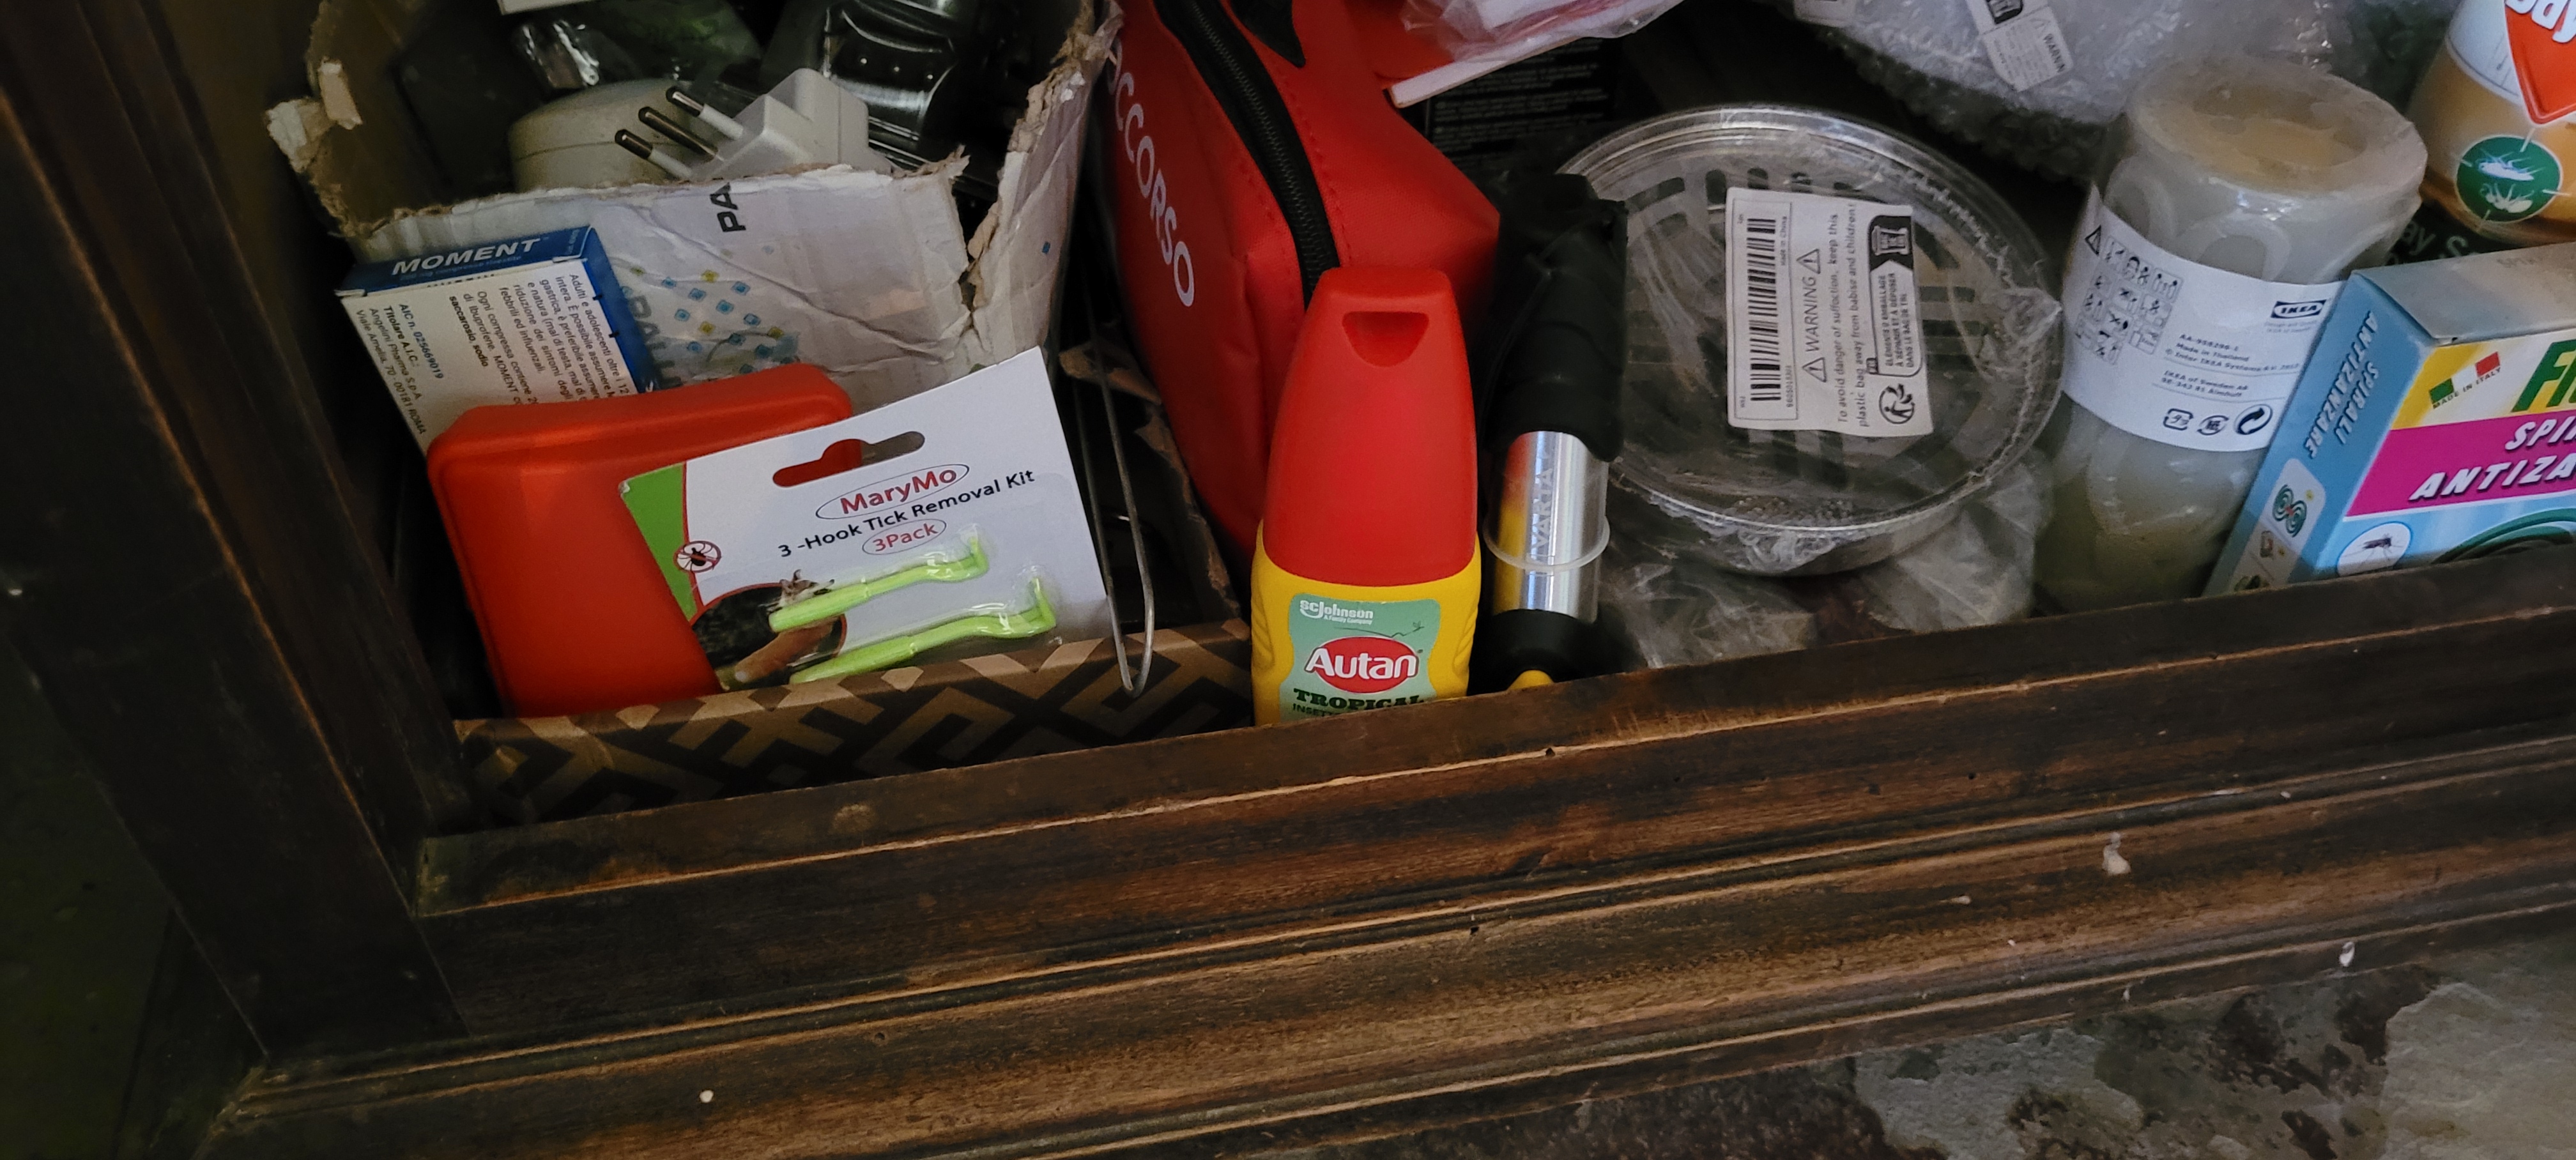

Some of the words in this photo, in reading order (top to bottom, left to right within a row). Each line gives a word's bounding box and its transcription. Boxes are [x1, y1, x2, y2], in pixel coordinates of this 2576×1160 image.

[392, 238, 540, 275] MOMENT
[1827, 240, 1838, 264] keep
[1845, 257, 1856, 276] and
[499, 287, 521, 317] febbrili
[531, 289, 549, 317] natura
[1802, 277, 1820, 353] WARNING
[356, 309, 372, 332] Viale
[383, 305, 405, 340] Titolare
[514, 317, 526, 330] ed
[543, 317, 560, 338] (mal
[555, 276, 572, 305] intera.
[569, 312, 594, 350] possibile
[588, 351, 611, 391] assumere
[569, 274, 587, 299] Adulti
[585, 309, 613, 356] adolescenti
[607, 357, 620, 377] oltre
[618, 383, 630, 394] 12
[1831, 326, 1841, 338] of
[1850, 315, 1860, 338] from
[369, 308, 394, 342] Angelini
[387, 344, 410, 376] Pharma
[399, 303, 414, 321] AIC
[408, 321, 416, 331] n.
[413, 331, 444, 379] 025669019
[463, 293, 474, 303] di
[493, 355, 519, 393] MOMENT
[477, 291, 494, 312] Ogni
[487, 313, 515, 360] compressa
[511, 360, 532, 395] contiene
[513, 284, 537, 326] riduzione
[533, 328, 544, 342] dei
[542, 345, 563, 378] sintomi
[558, 379, 574, 401] degli
[519, 330, 546, 374] influenzali.
[539, 279, 562, 315] gastrica,
[559, 322, 585, 362] preferibile
[579, 362, 601, 399] assumer
[553, 337, 564, 346] di
[1853, 341, 1864, 365] away
[2176, 342, 2199, 353] Made
[2212, 351, 2250, 362] Thailand
[473, 344, 489, 367] sodio
[557, 347, 572, 370] testa,
[1832, 340, 1845, 375] danger
[2174, 352, 2198, 362] Inter
[2200, 358, 2222, 367] IKEA
[2224, 362, 2261, 371] Systems
[569, 371, 583, 387] mal
[575, 386, 586, 396] di
[1834, 378, 1847, 408] avoid
[2164, 370, 2187, 381] IKEA
[2200, 378, 2234, 390] Sweden
[2303, 310, 2379, 460] ANTIZANZARE
[2432, 391, 2460, 409] MADE
[2462, 383, 2473, 393] IN
[2476, 367, 2501, 385] ITALY
[1854, 392, 1869, 427] plastic
[2334, 362, 2379, 445] SPIRALI
[839, 469, 957, 515] MaryMo
[778, 544, 792, 558] 3
[862, 510, 908, 533] Tick
[912, 480, 1001, 519] Removal
[1005, 468, 1036, 489] Kit
[1531, 468, 1554, 549] VARTA
[873, 521, 938, 553] 3Pack
[1305, 647, 1418, 680] Autan
[1293, 687, 1424, 710] TROPICAL
